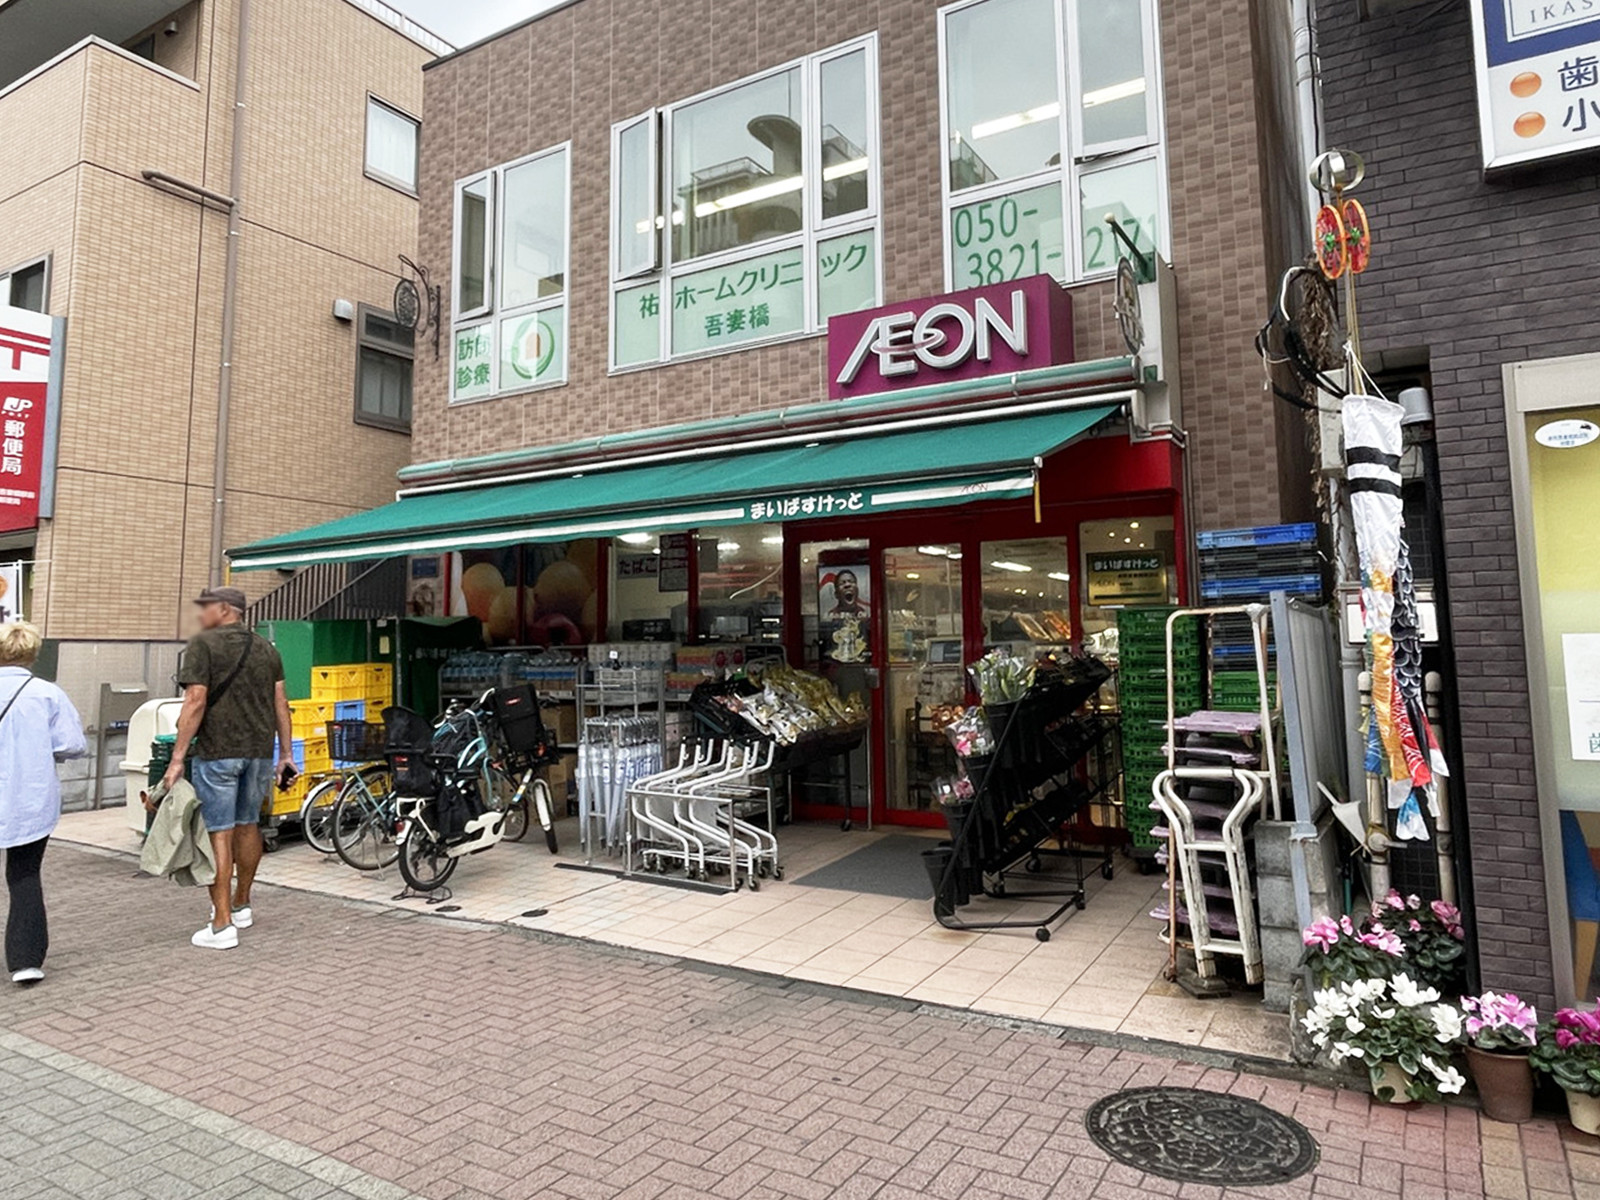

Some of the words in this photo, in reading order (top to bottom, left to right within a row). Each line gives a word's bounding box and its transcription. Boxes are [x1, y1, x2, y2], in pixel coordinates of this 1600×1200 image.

[1557, 56, 1599, 92] 歯
[1562, 98, 1600, 132] 小
[954, 198, 1038, 248] 050-
[704, 302, 770, 338] 吾妻橋
[457, 363, 490, 389] 診療
[1, 419, 26, 476] 郵便局
[750, 492, 864, 519] まいばすけっと
